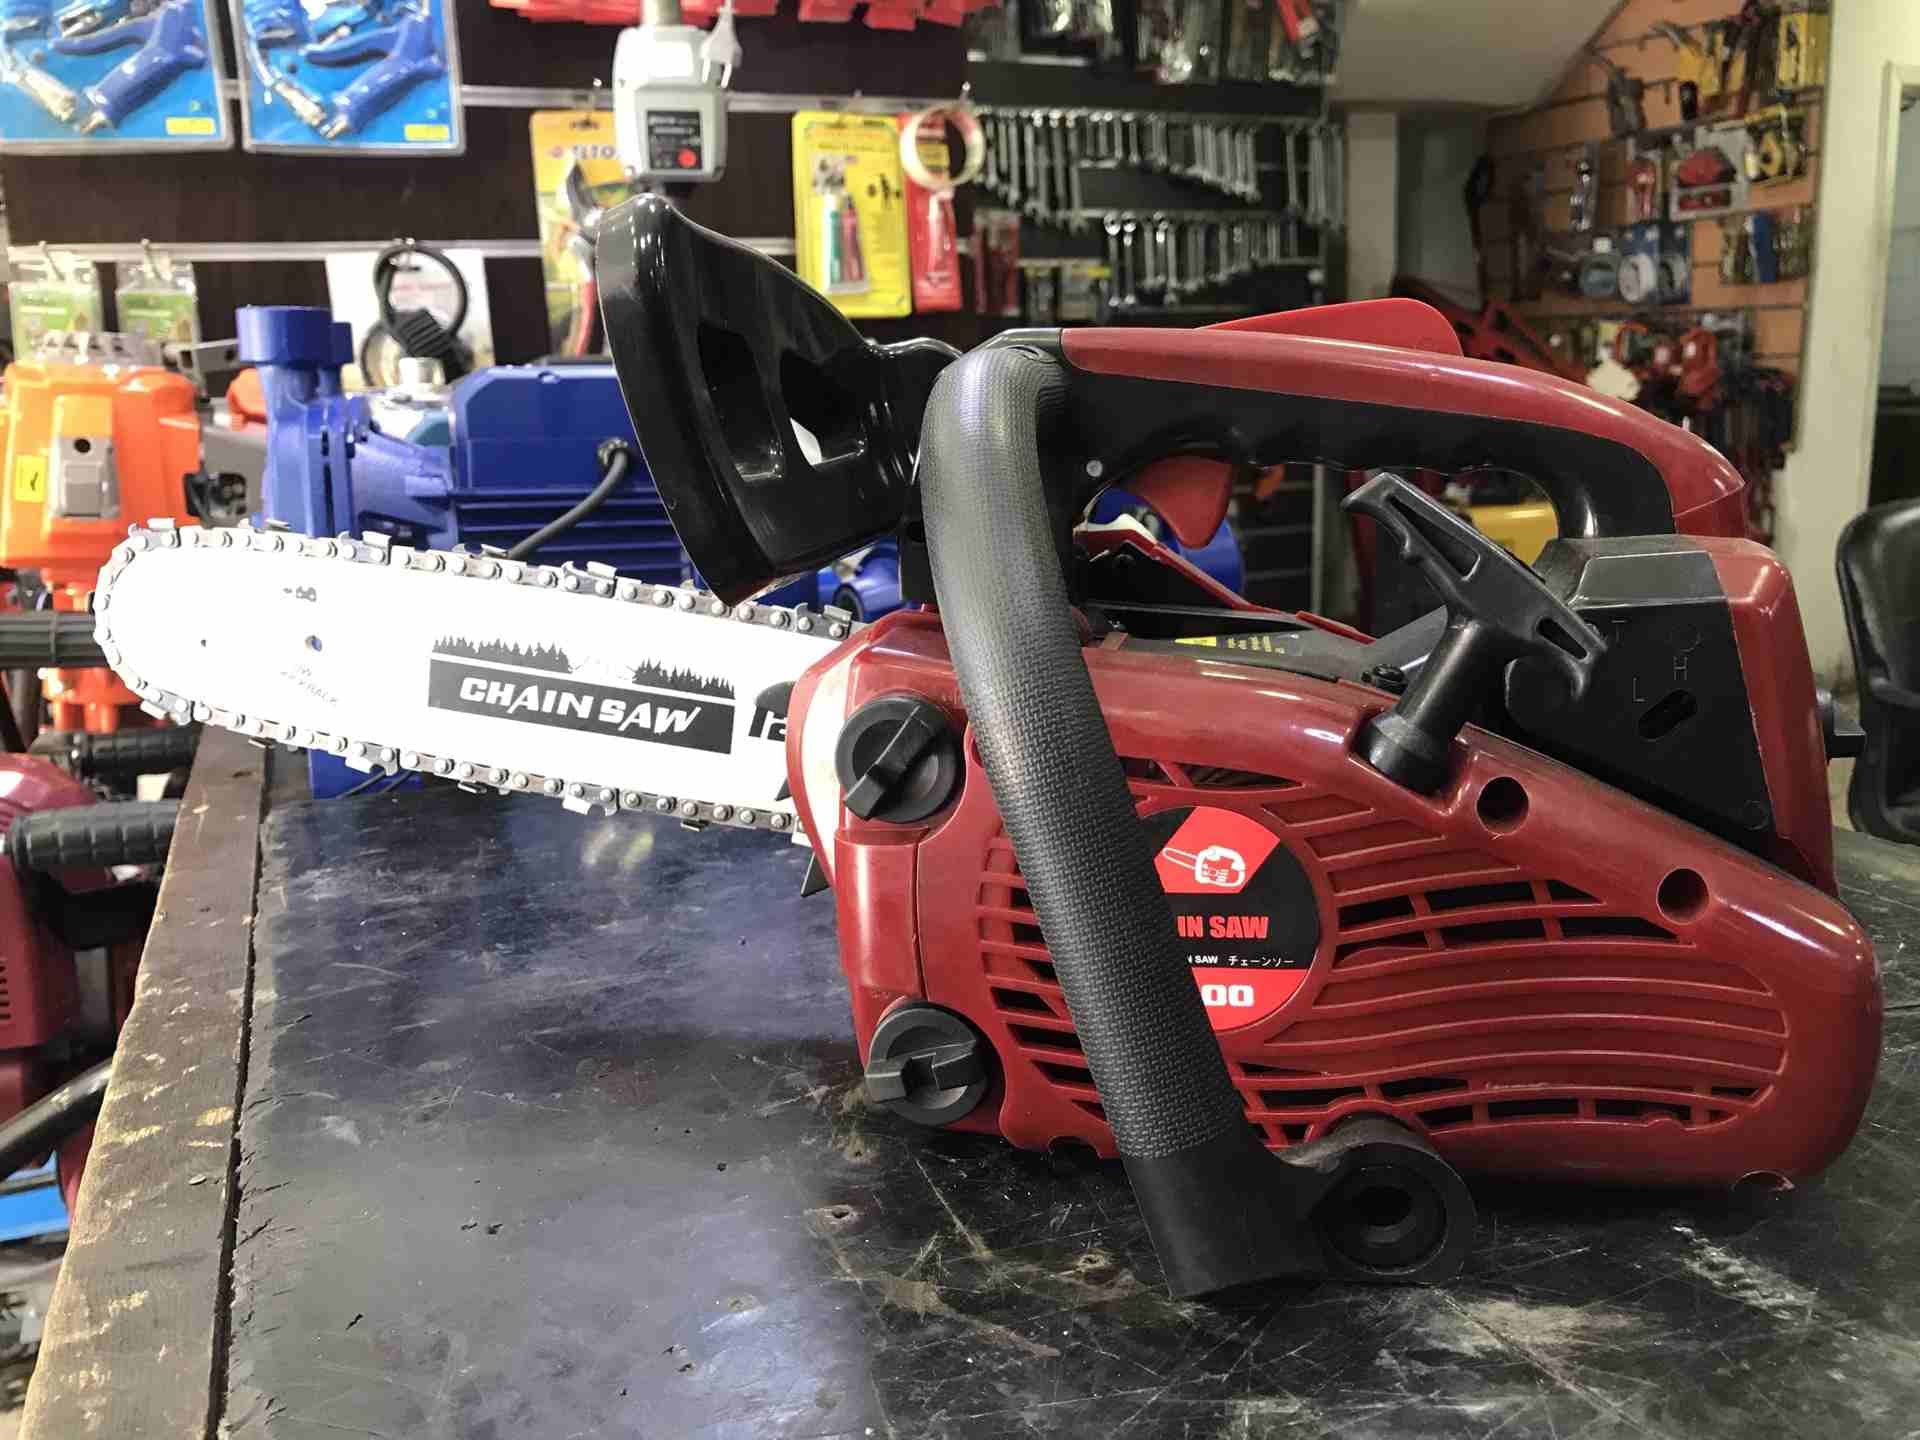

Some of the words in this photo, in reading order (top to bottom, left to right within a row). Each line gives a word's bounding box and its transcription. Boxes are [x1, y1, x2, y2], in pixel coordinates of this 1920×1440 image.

[459, 676, 594, 719] CHAIN
[598, 698, 702, 734] SAW
[1209, 915, 1269, 939] SAW
[1194, 955, 1219, 964] SAW
[1228, 955, 1295, 967] チェーンソー
